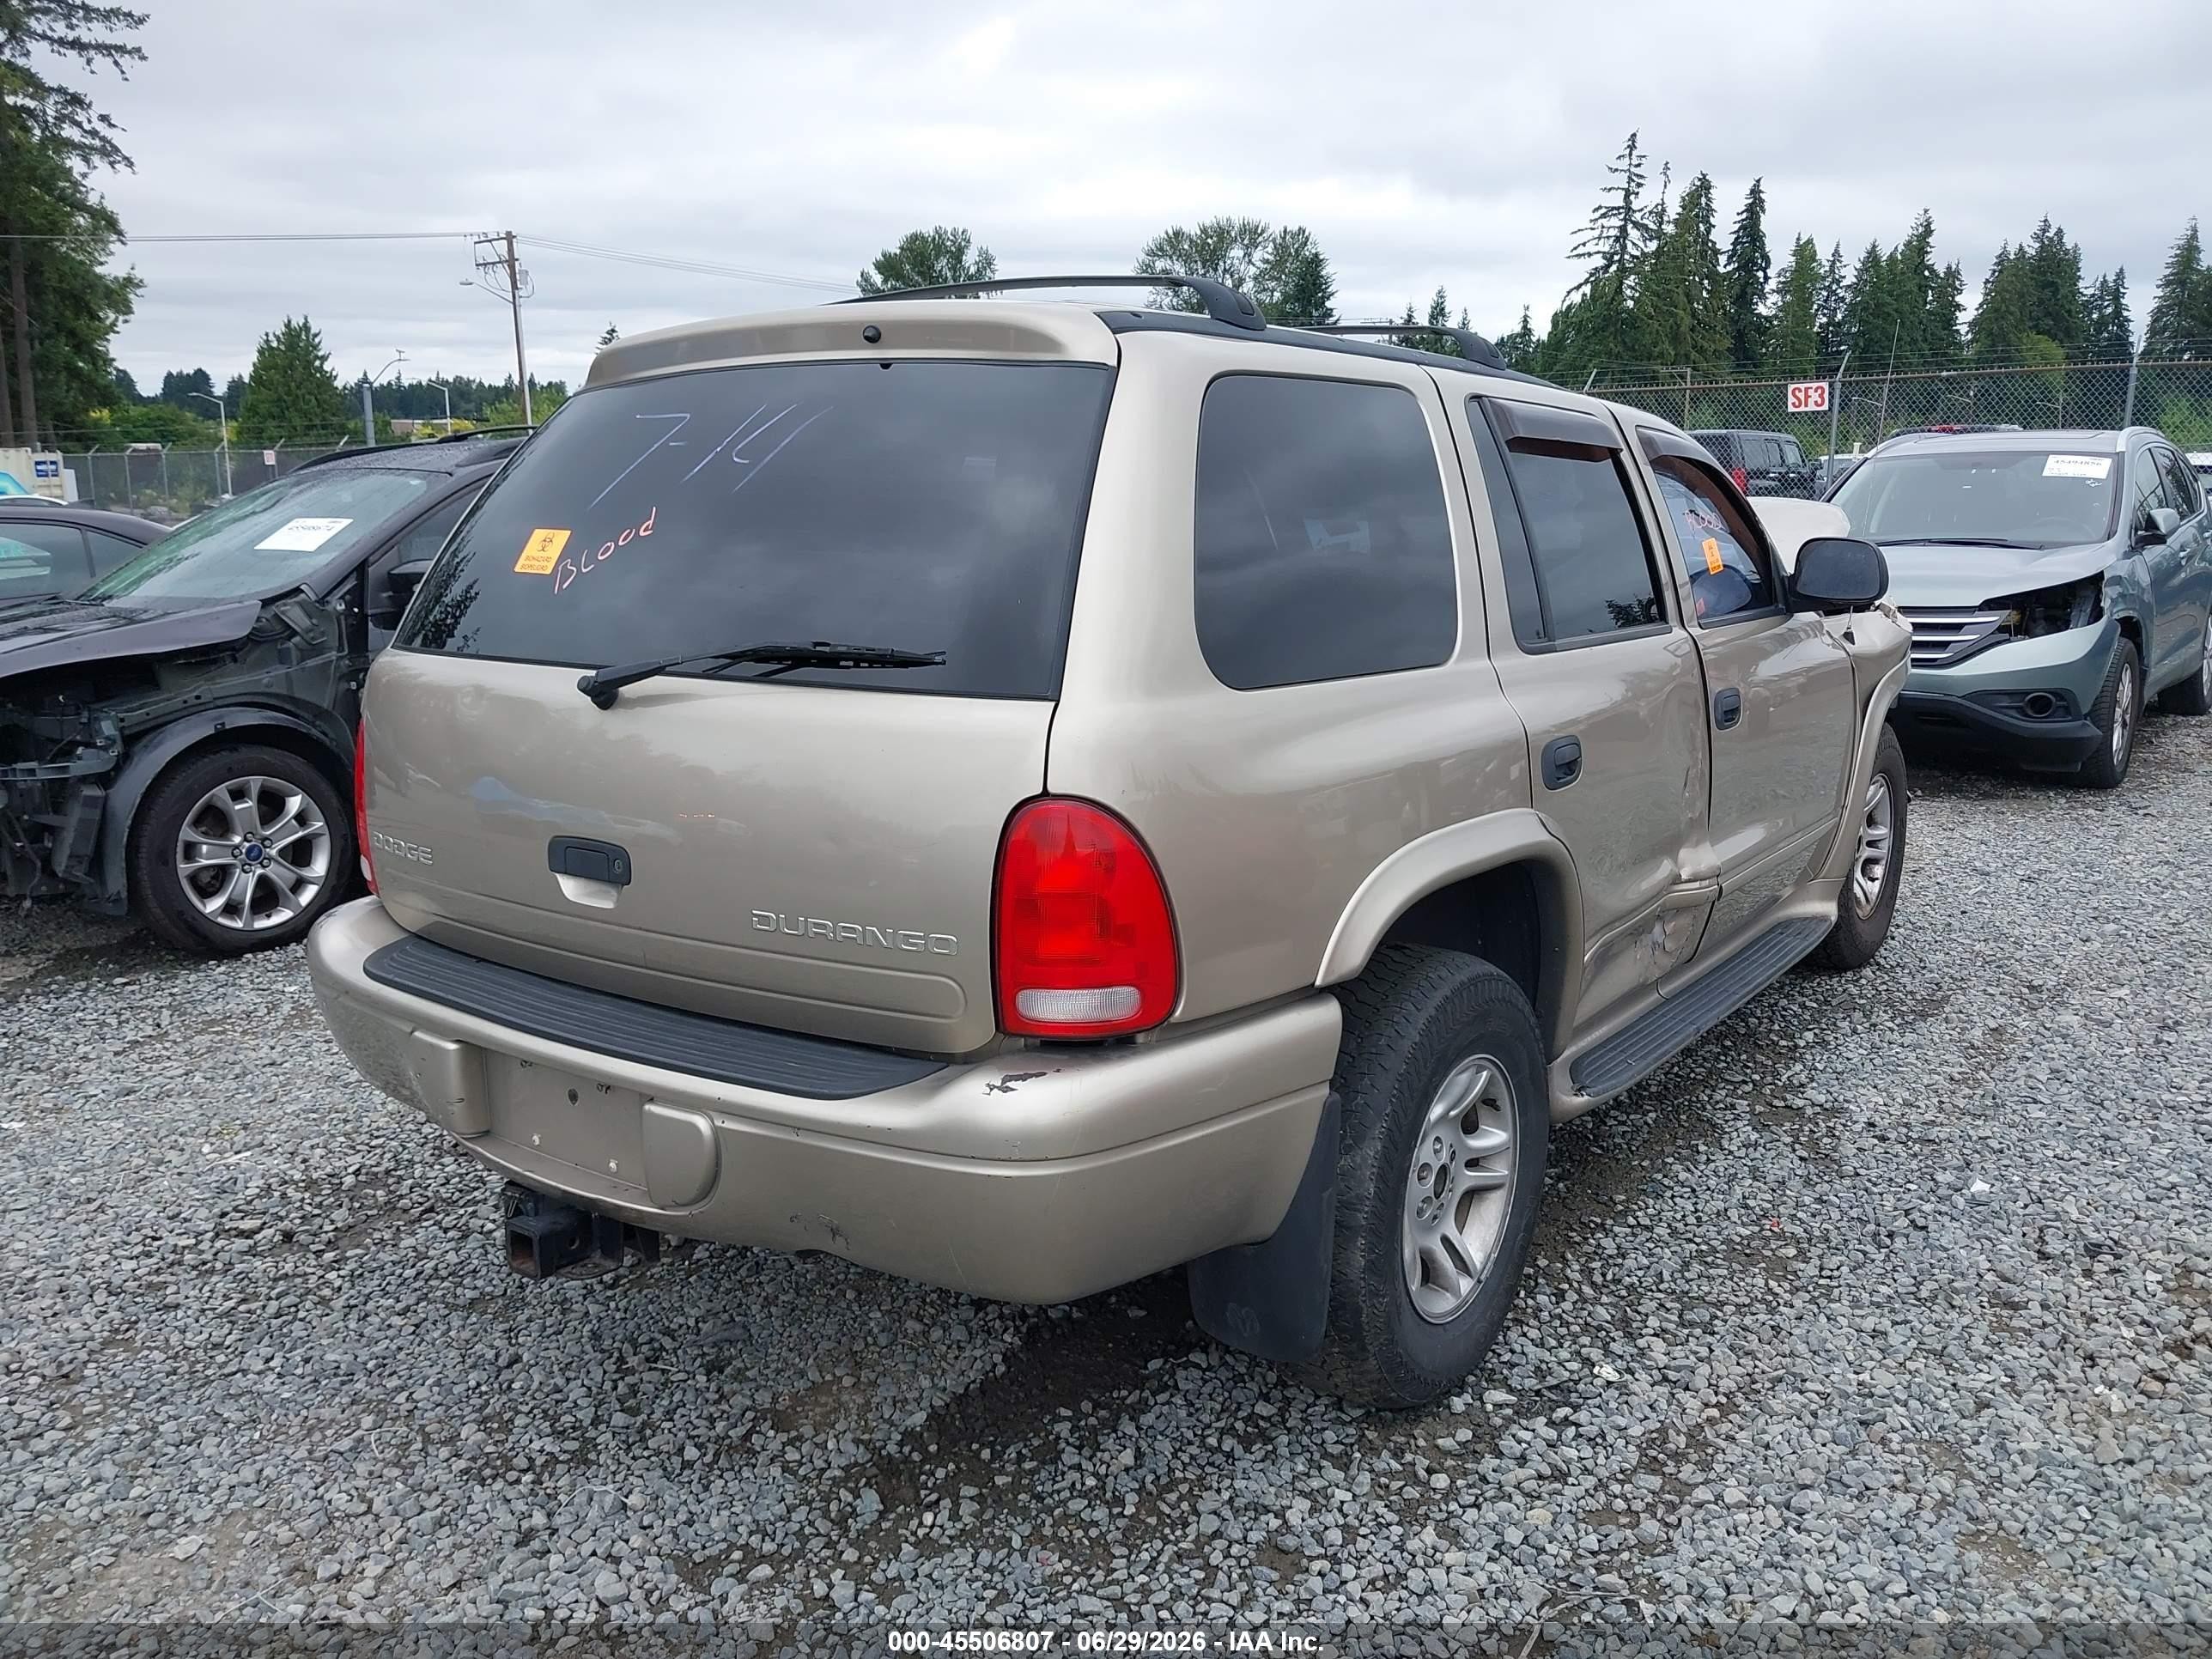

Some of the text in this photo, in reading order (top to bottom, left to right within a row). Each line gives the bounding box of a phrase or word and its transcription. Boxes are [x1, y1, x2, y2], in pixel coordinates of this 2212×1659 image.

[1791, 385, 1826, 409] SF3
[373, 830, 433, 866] DODGE
[750, 908, 958, 956] DURANGO
